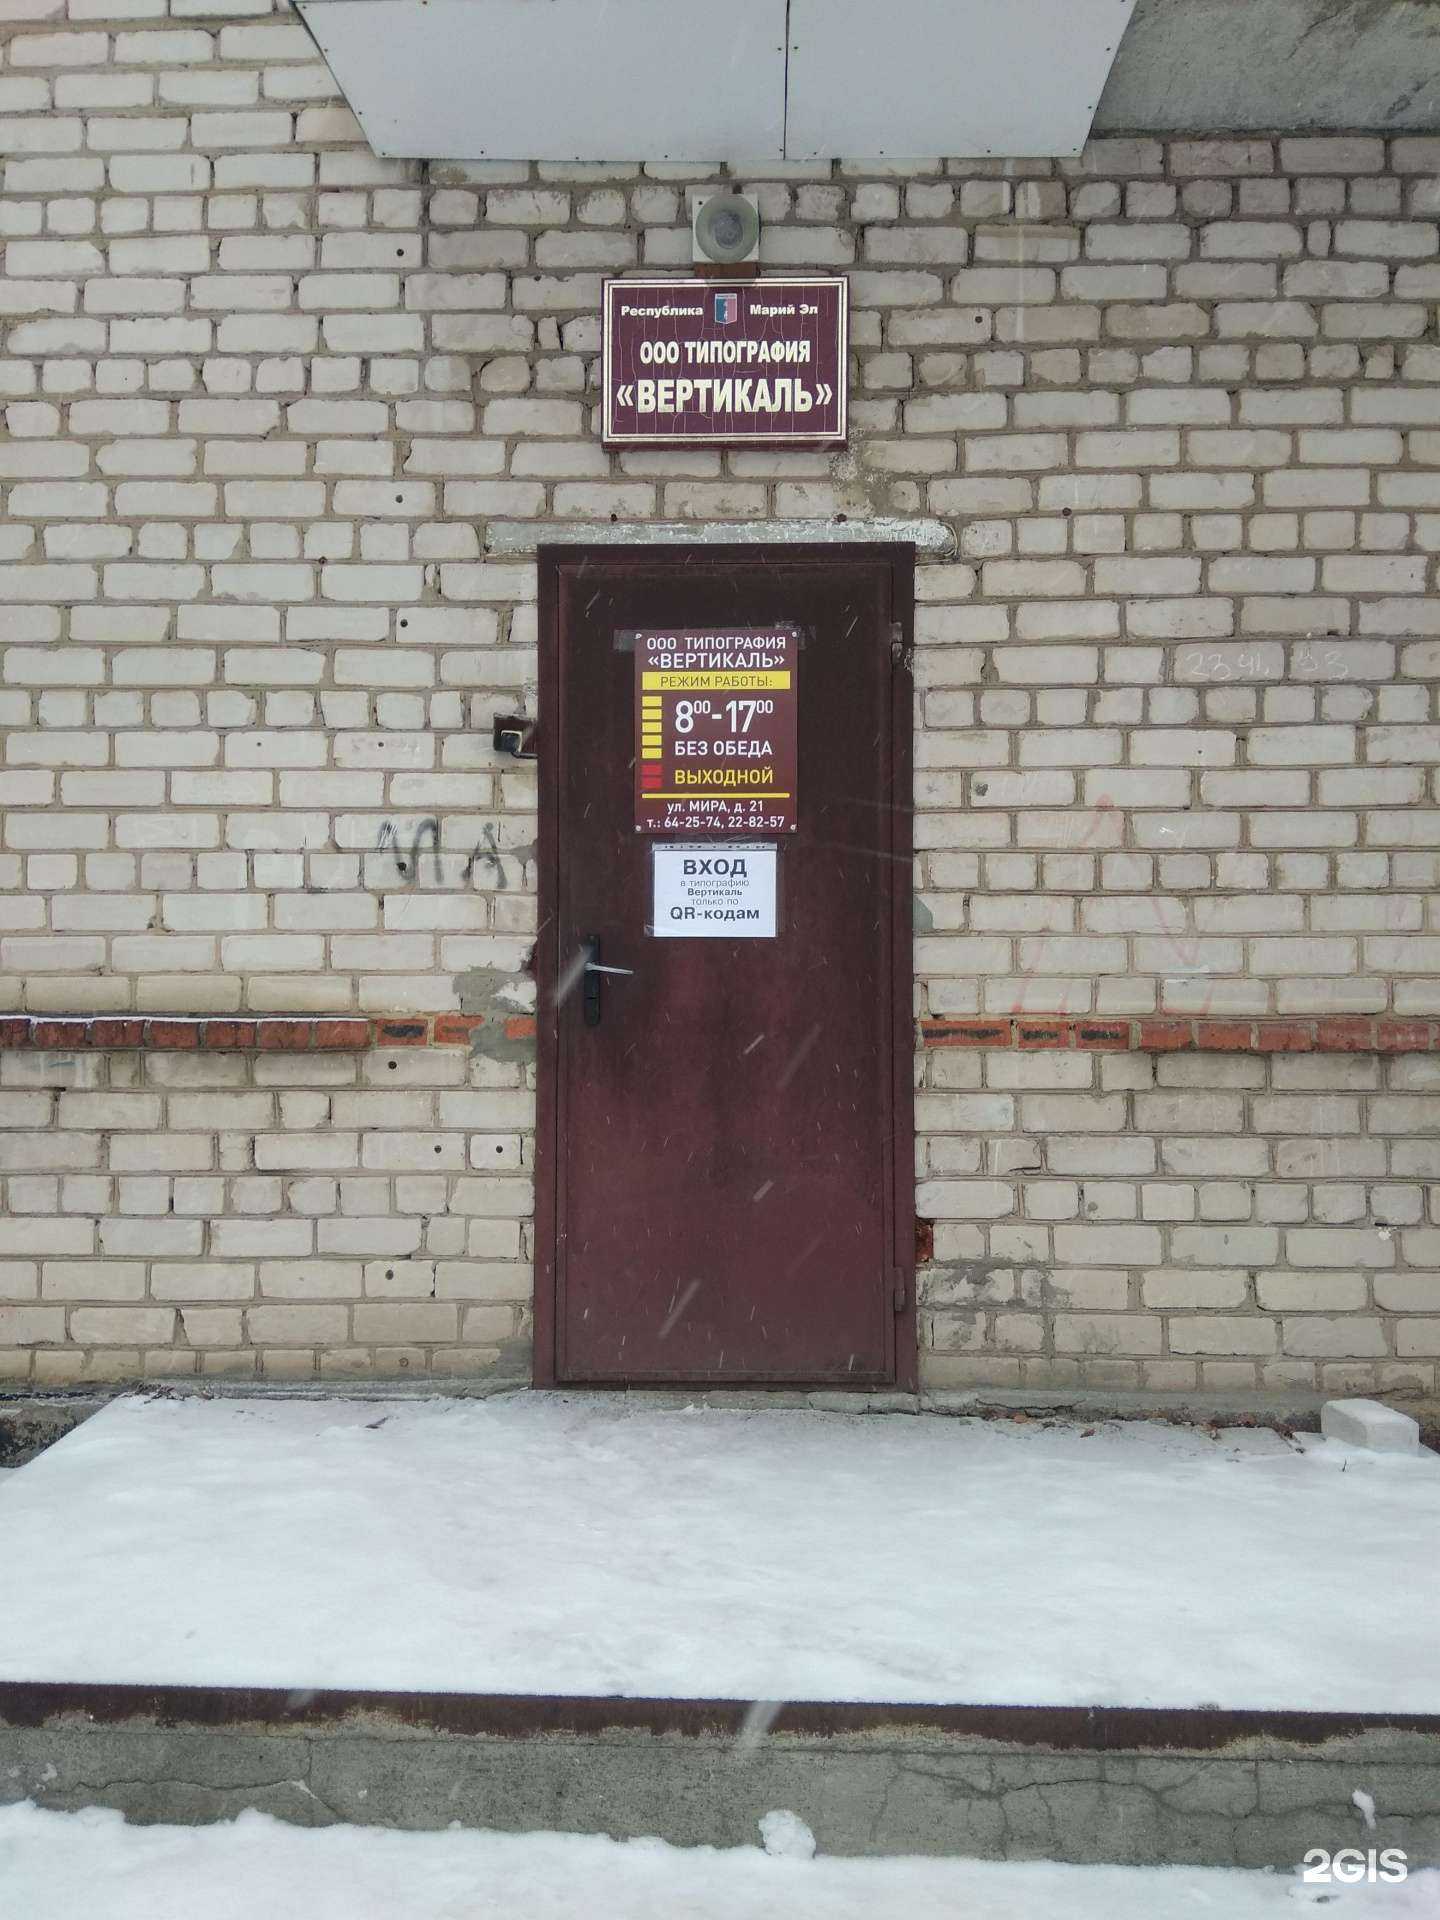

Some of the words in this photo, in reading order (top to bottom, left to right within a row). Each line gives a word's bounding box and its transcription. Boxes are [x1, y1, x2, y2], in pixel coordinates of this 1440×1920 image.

[621, 305, 704, 317] Республика
[750, 304, 795, 316] Марий
[799, 304, 818, 315] Эл
[640, 341, 679, 364] ООО
[684, 340, 811, 364] ТИПОГРАФИЯ
[616, 378, 833, 413] «ВЕРТИКАЛЬ»
[647, 637, 677, 650] ООО
[685, 636, 786, 650] ТИПОГРАФИЯ
[647, 652, 785, 669] «ВЕРТИКАЛЬ»
[660, 676, 710, 688] РЕЖИМ
[714, 675, 773, 687] РАБОТЫ:
[674, 741, 708, 756] БЕЗ
[713, 740, 773, 758] ОБЕДА
[674, 766, 774, 786] ВЫХОДНОЙ
[667, 802, 685, 813] ул.
[689, 801, 731, 813] МИРА,
[734, 802, 746, 813] д.
[749, 801, 763, 812] 21
[664, 816, 725, 829] 64-25-74,
[728, 816, 785, 828] 22-82-57
[683, 858, 747, 878] ВХОД
[690, 879, 750, 888] типографию
[687, 888, 743, 897] Вертикаль
[692, 898, 724, 906] только
[727, 898, 739, 906] по
[670, 906, 760, 921] QR-кодам
